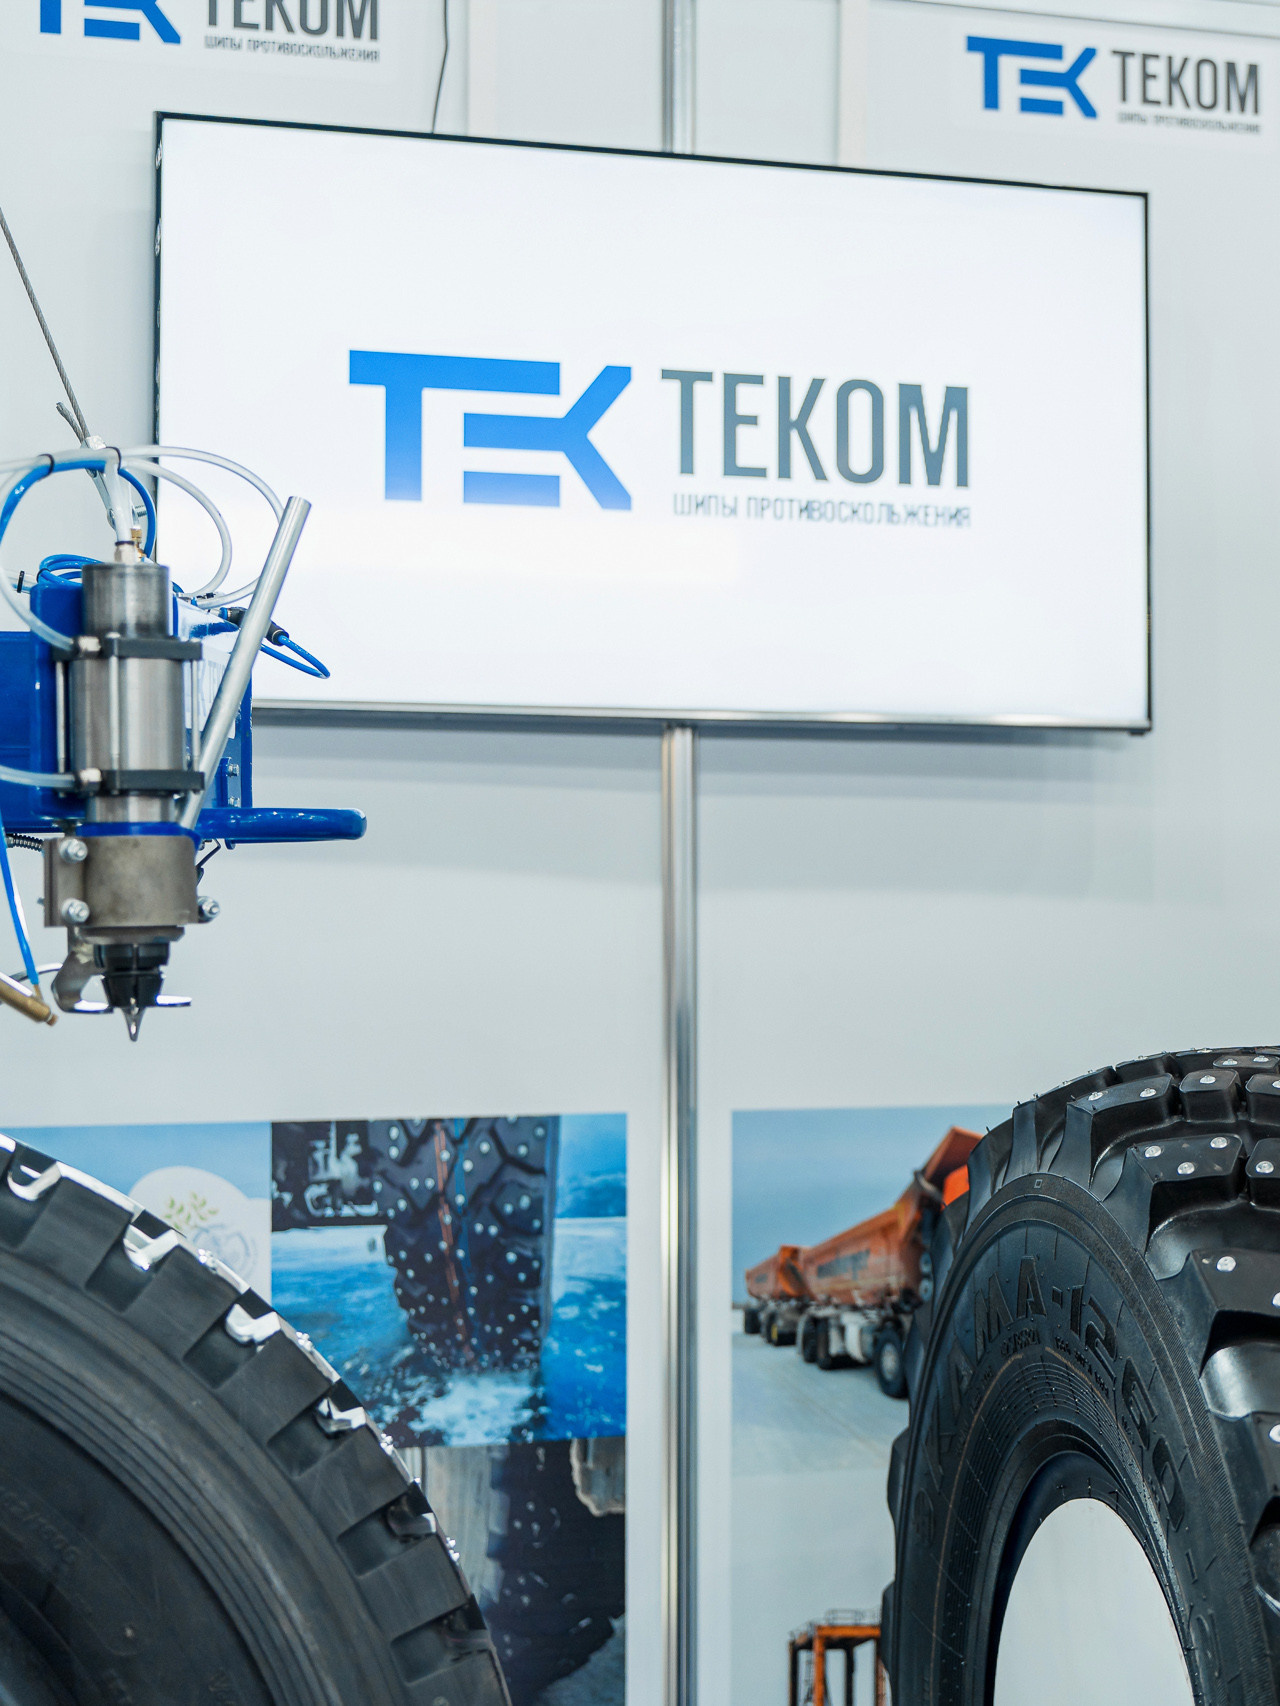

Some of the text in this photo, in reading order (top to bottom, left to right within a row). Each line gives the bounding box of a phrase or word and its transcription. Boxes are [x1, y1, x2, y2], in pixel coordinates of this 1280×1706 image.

[1111, 49, 1260, 115] ТЕКОМ
[349, 349, 969, 510] ТЕК ТЕКОМ
[673, 493, 970, 528] ШИПЫ ПРОТИВОСКОЛЬЖЕНИЯ
